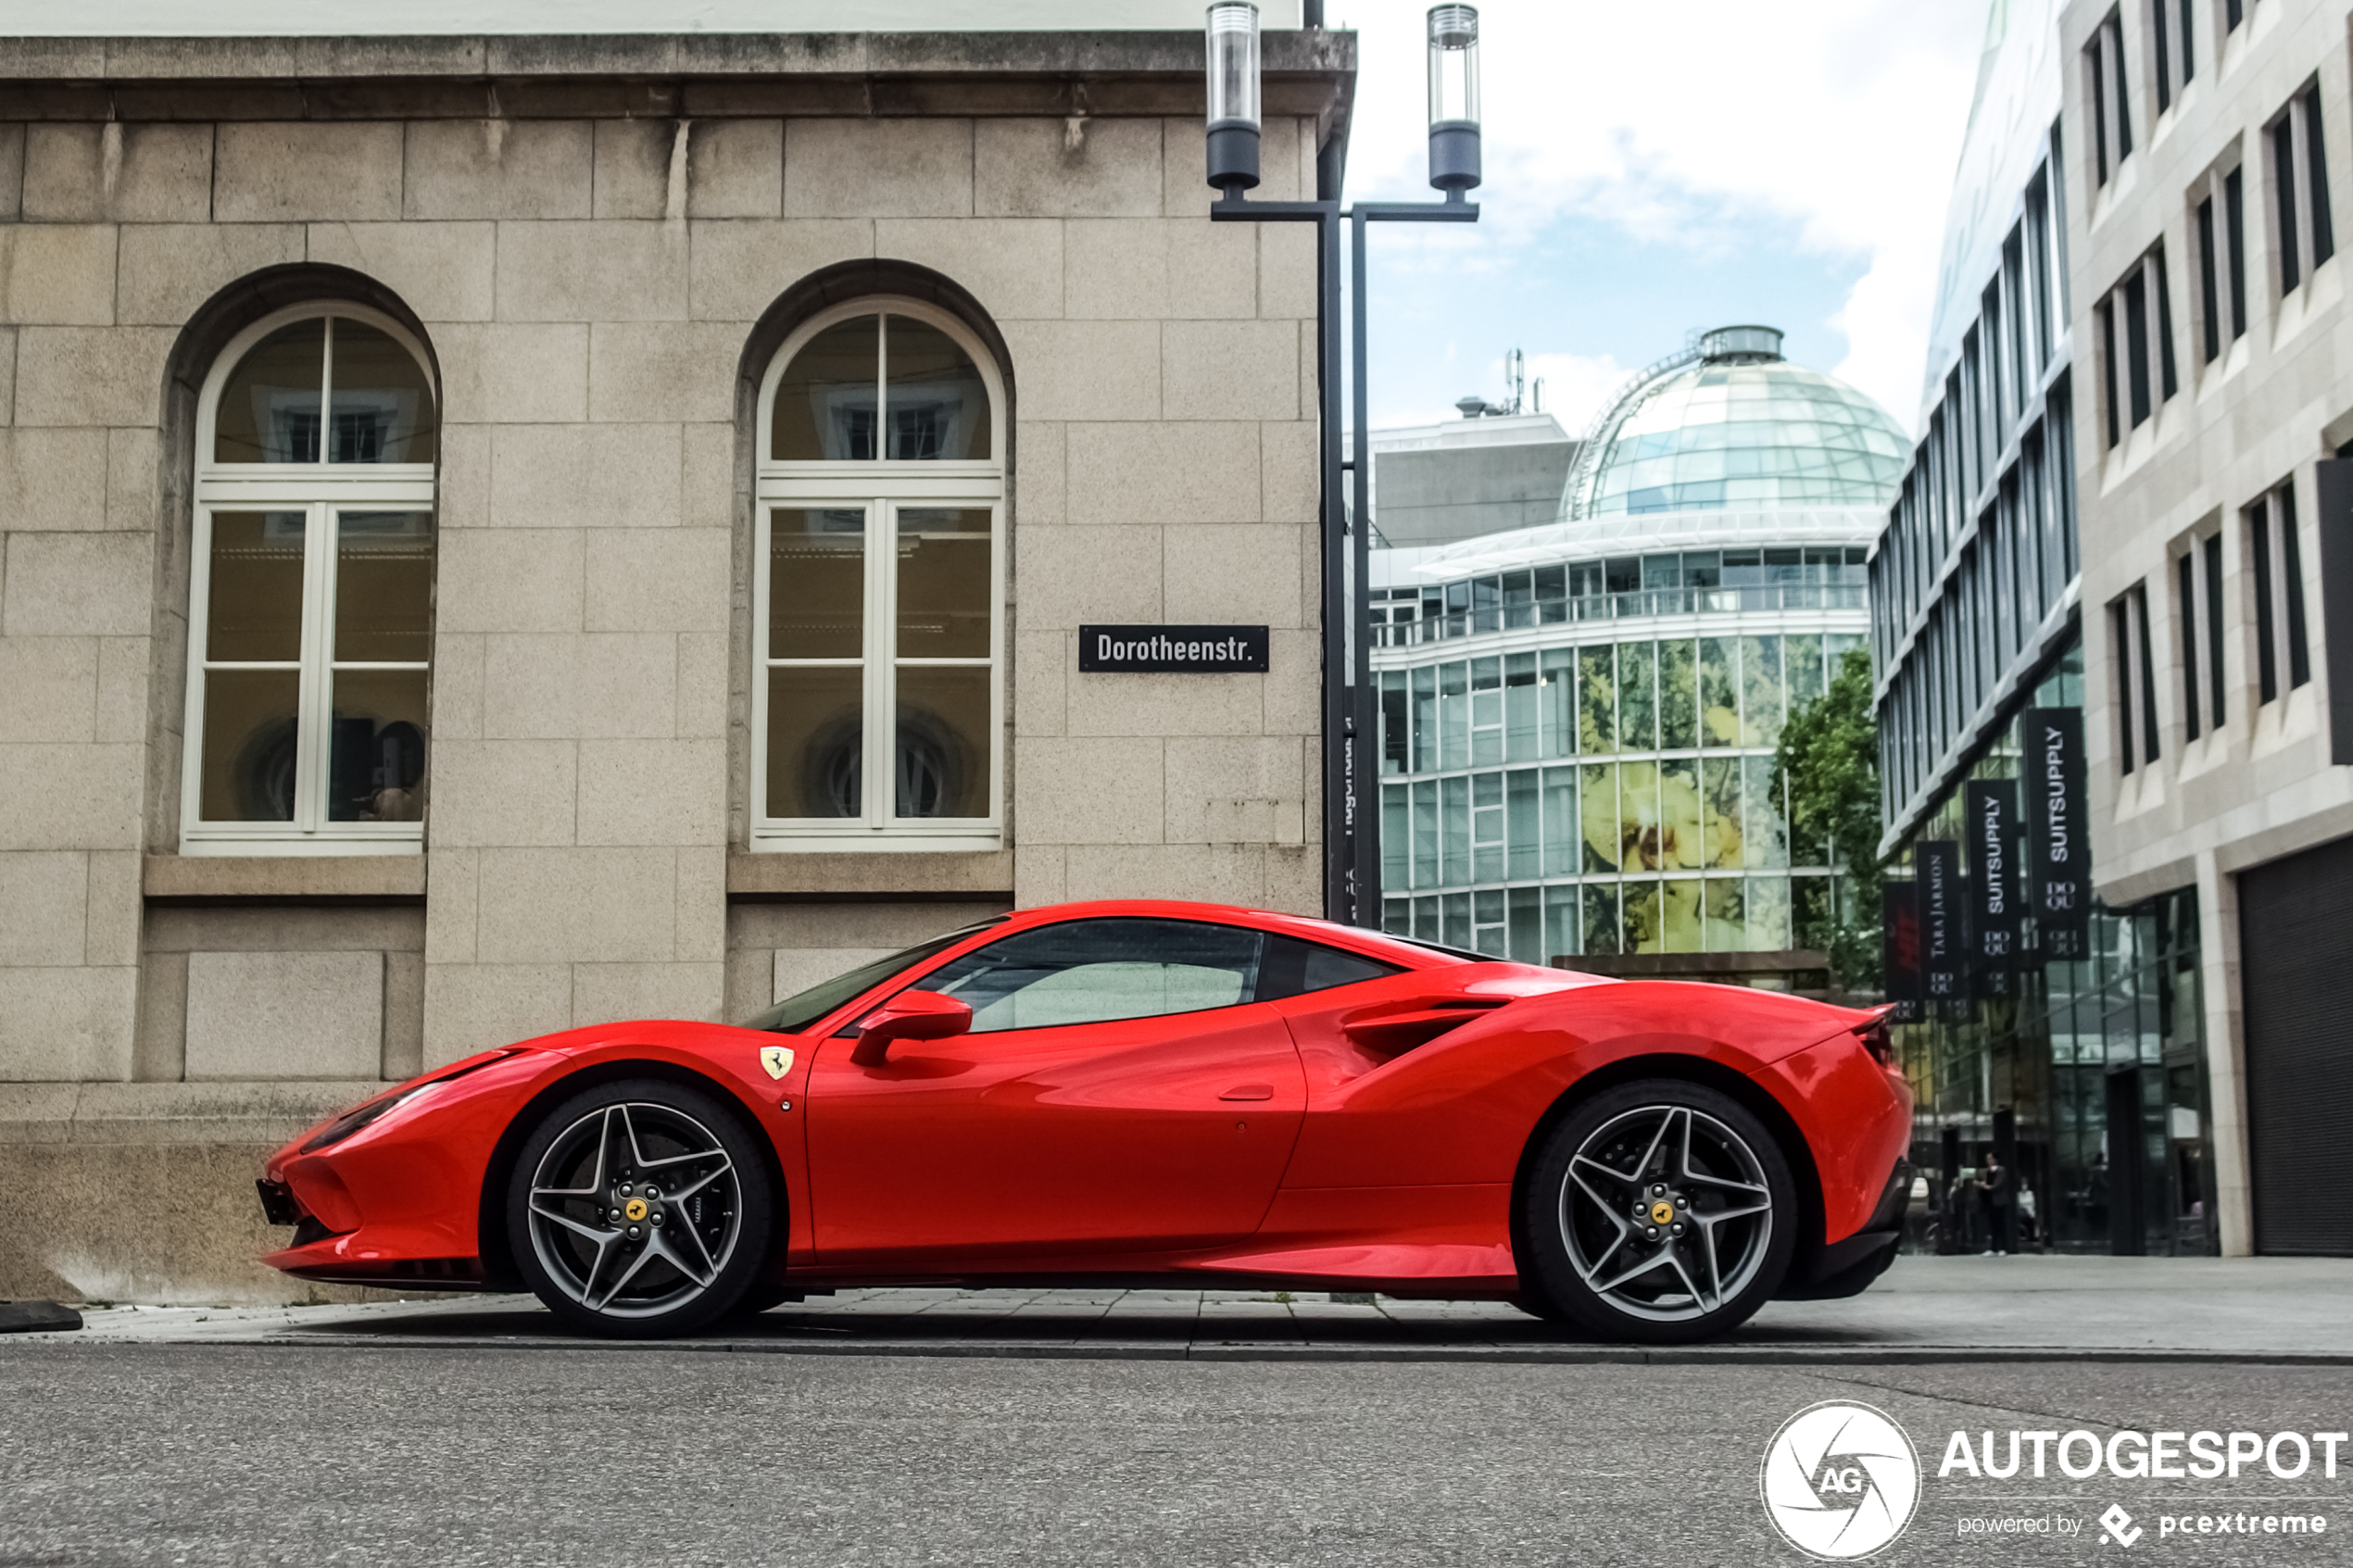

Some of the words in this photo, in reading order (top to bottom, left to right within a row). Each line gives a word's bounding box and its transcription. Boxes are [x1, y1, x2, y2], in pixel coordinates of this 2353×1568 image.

[1098, 633, 1253, 661] Dorotheenstr.
[2045, 725, 2070, 863] SUITSUPPLY
[1930, 853, 1946, 917] JARMON
[1984, 795, 2005, 915] SUITSUPPLY
